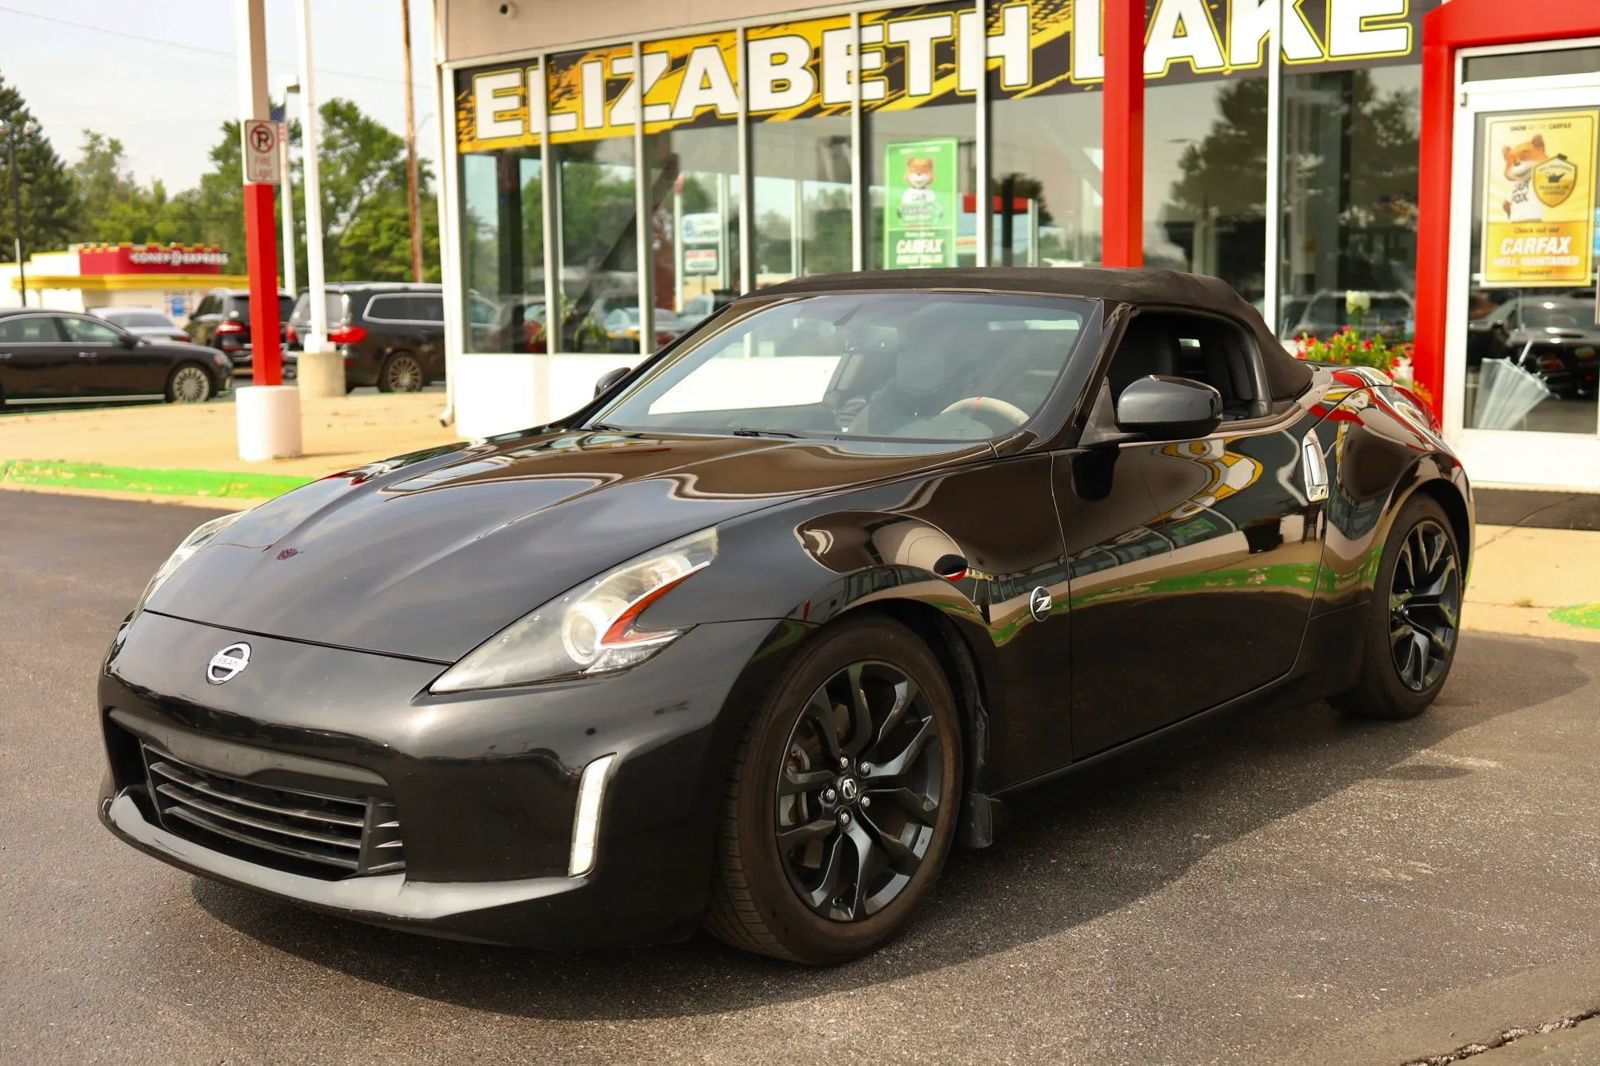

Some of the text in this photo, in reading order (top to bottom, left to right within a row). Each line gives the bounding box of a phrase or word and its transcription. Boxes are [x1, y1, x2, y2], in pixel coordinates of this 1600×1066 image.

[473, 0, 1411, 140] ELIZABETH LAKE
[896, 239, 944, 254] CARFAX
[1501, 236, 1572, 255] CARFAX
